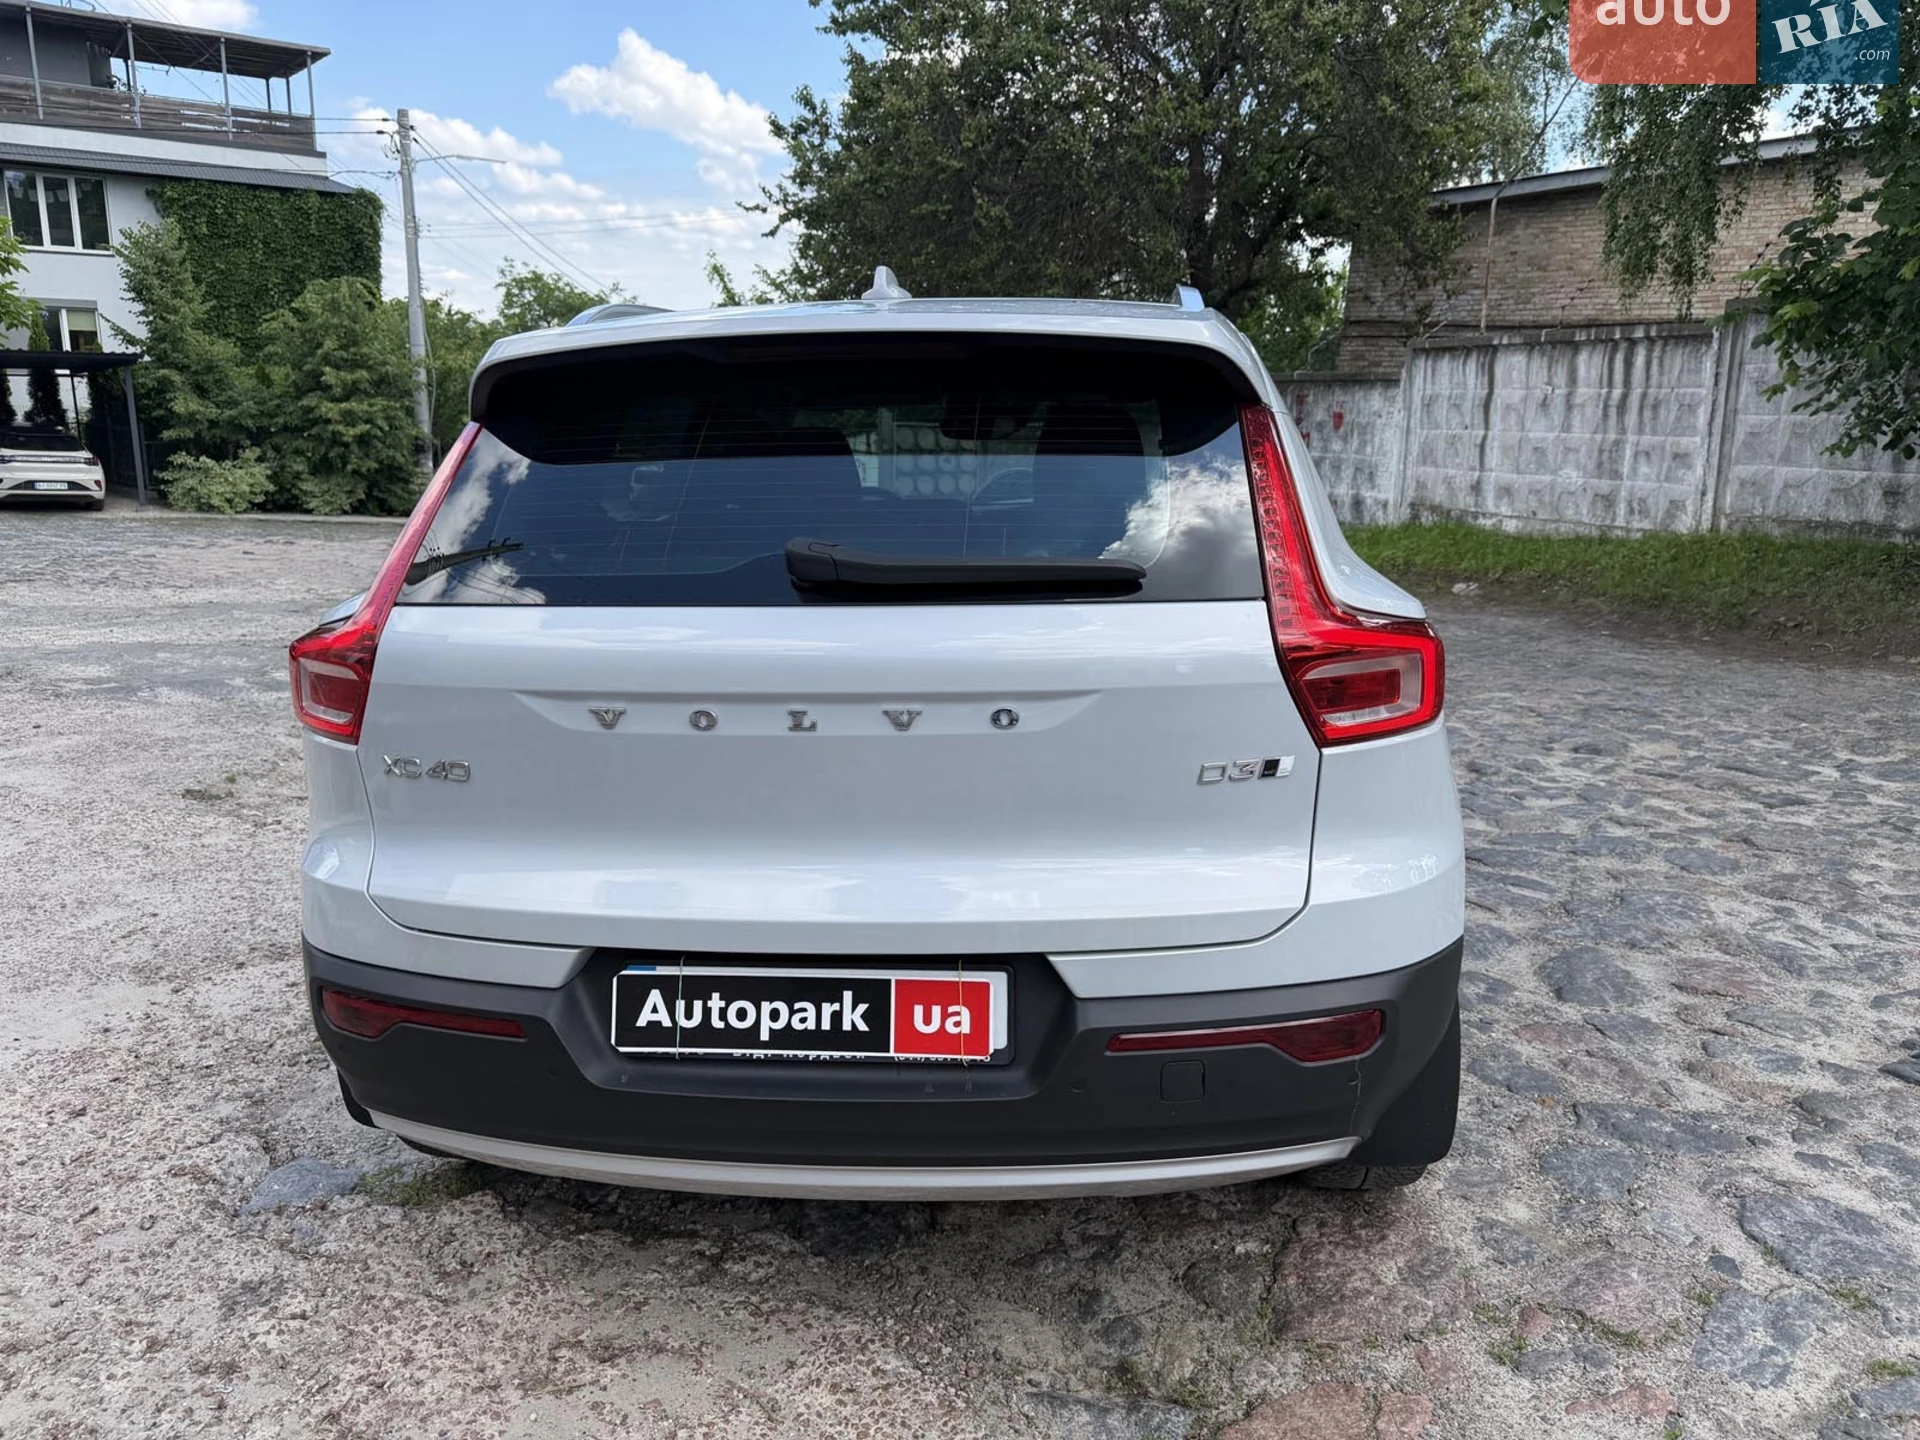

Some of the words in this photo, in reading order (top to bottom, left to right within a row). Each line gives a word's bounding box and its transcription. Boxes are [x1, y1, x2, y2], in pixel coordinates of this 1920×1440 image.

[588, 706, 1019, 732] VOLVO
[1197, 759, 1259, 786] D3
[635, 988, 871, 1041] Autopark
[912, 1003, 973, 1034] ua
